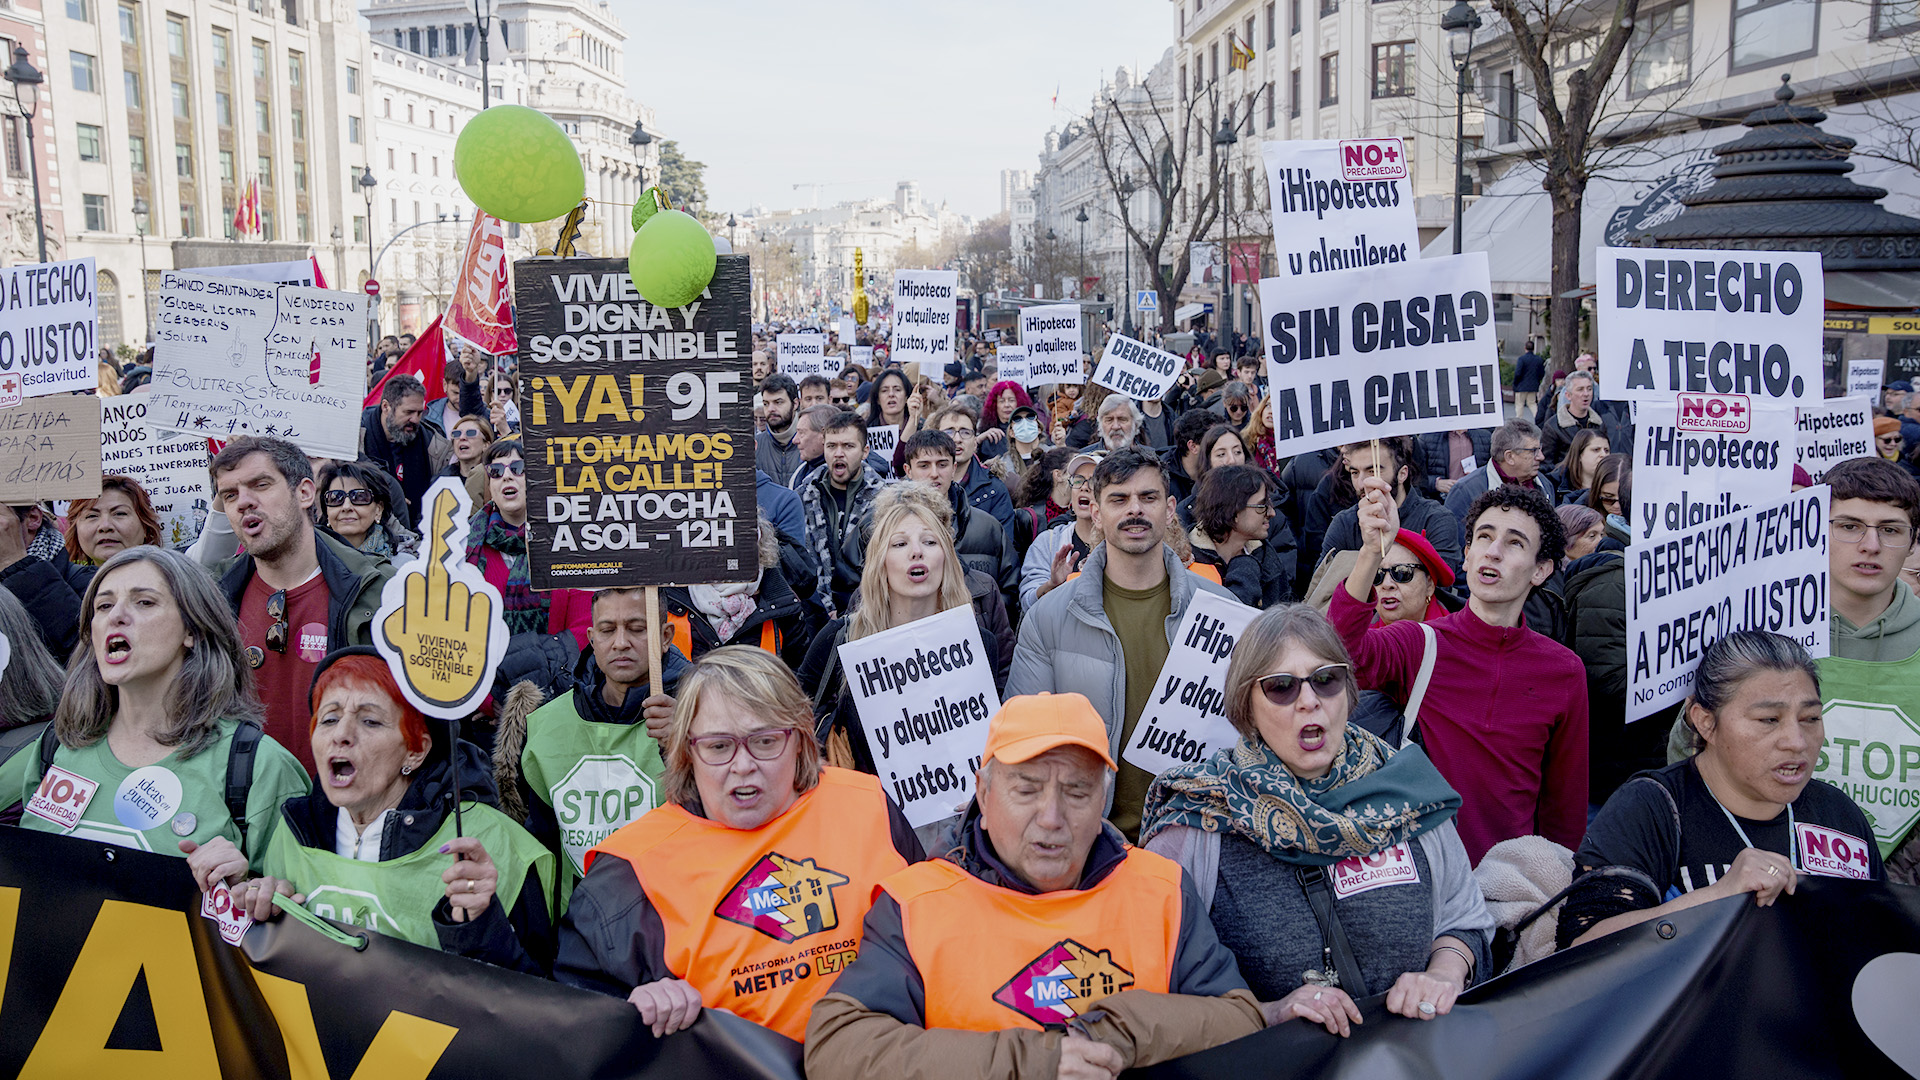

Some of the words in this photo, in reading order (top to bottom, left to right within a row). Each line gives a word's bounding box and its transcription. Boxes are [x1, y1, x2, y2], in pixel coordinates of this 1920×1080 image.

[1345, 145, 1398, 166] NO+
[1346, 166, 1402, 176] PRECARIEDAD
[10, 272, 22, 310] A
[25, 263, 92, 308] TECHO,
[165, 274, 204, 292] BANCO
[207, 282, 274, 300] SANTANDER
[551, 273, 712, 302] VIVIE
[899, 279, 951, 300] ¡Hipotecas
[1616, 258, 1803, 315] DERECHO
[164, 295, 207, 313] GLOBAL
[213, 305, 257, 318] LICATA
[285, 295, 355, 312] VENDIERON
[163, 312, 229, 331] CERBERUS
[281, 312, 301, 325] MI
[310, 317, 345, 326] CASA
[564, 303, 672, 333] DIGNA
[678, 302, 701, 330] Y
[897, 311, 903, 326] y
[905, 307, 950, 327] alquileres
[1026, 317, 1076, 333] ¡Hipotecas
[1270, 306, 1340, 364] SIN
[1351, 290, 1489, 353] CASA?
[1824, 319, 1854, 329] CKETS
[21, 320, 94, 368] JUSTO!
[163, 330, 208, 344] SOLVIA
[273, 334, 302, 344] CON
[332, 338, 357, 349] MI
[530, 331, 738, 363] SOSTENIBLE
[896, 333, 928, 352] justos,
[931, 335, 949, 354] ya!
[1027, 343, 1033, 357] y
[1035, 337, 1077, 355] alquileres
[267, 347, 310, 360] FAMILIA
[1111, 338, 1176, 377] DERECHO
[786, 361, 820, 375] alquileres
[1030, 361, 1060, 379] justos,
[1062, 359, 1078, 376] ya!
[1102, 366, 1115, 384] A
[1625, 338, 1655, 390] A
[1664, 340, 1804, 398] TECHO.
[531, 374, 645, 425] ¡YA!
[665, 371, 740, 421] 9F
[1279, 387, 1304, 441] A
[1309, 380, 1355, 435] LA
[1363, 364, 1496, 426] CALLE!
[1682, 398, 1745, 419] NO+
[102, 403, 148, 425] ANCO
[122, 421, 128, 430] y
[1682, 418, 1746, 429] PRECARIEDAD
[101, 427, 147, 446] ONDOS
[867, 430, 894, 450] RECHO
[101, 447, 143, 462] ANDES
[546, 433, 734, 465] ¡TOMAMOS
[1645, 426, 1780, 475] ¡Hipotecas
[1796, 446, 1804, 463] y
[1808, 438, 1867, 461] alquileres
[6, 450, 86, 484] demás
[102, 464, 147, 476] EQUEÑOS
[555, 466, 602, 493] LA
[605, 462, 723, 492] CALLE!
[164, 484, 202, 495] JUGAR
[547, 495, 591, 523] DE
[596, 491, 737, 521] ATOCHA
[1643, 503, 1657, 539] y
[551, 524, 578, 552] A
[581, 523, 650, 551] SOL
[677, 519, 735, 548] 12H
[551, 562, 623, 570] #9FTOMAMOSLACALLE
[1633, 522, 1732, 621] ¡DERECHO
[1733, 517, 1749, 568] A
[1753, 496, 1826, 561] TECHO,
[1633, 631, 1651, 684] A
[1656, 596, 1732, 675] PRECIO
[1736, 572, 1826, 633] JUSTO!
[417, 633, 468, 653] VIVIENDA
[420, 645, 455, 662] DIGNA
[457, 652, 465, 663] Y
[409, 654, 473, 677] SOSTENIBLE
[432, 669, 451, 684] ¡YA!
[855, 638, 974, 698] ¡Hipotecas
[1159, 675, 1181, 705] y
[1634, 690, 1654, 706] No
[875, 725, 889, 759] y
[893, 692, 989, 746] alquileres
[890, 762, 966, 811] justos,
[1816, 778, 1920, 808] AHUCIOS
[122, 787, 159, 820] guerra
[560, 785, 644, 825] STOP
[1804, 830, 1868, 868] NO+
[1340, 866, 1411, 889] PRECARIEDAD
[753, 889, 789, 910] Me
[731, 955, 796, 977] PLATAFORMA
[798, 938, 857, 959] AFECTADOS
[733, 962, 812, 998] METRO
[1037, 979, 1077, 1001] Me
